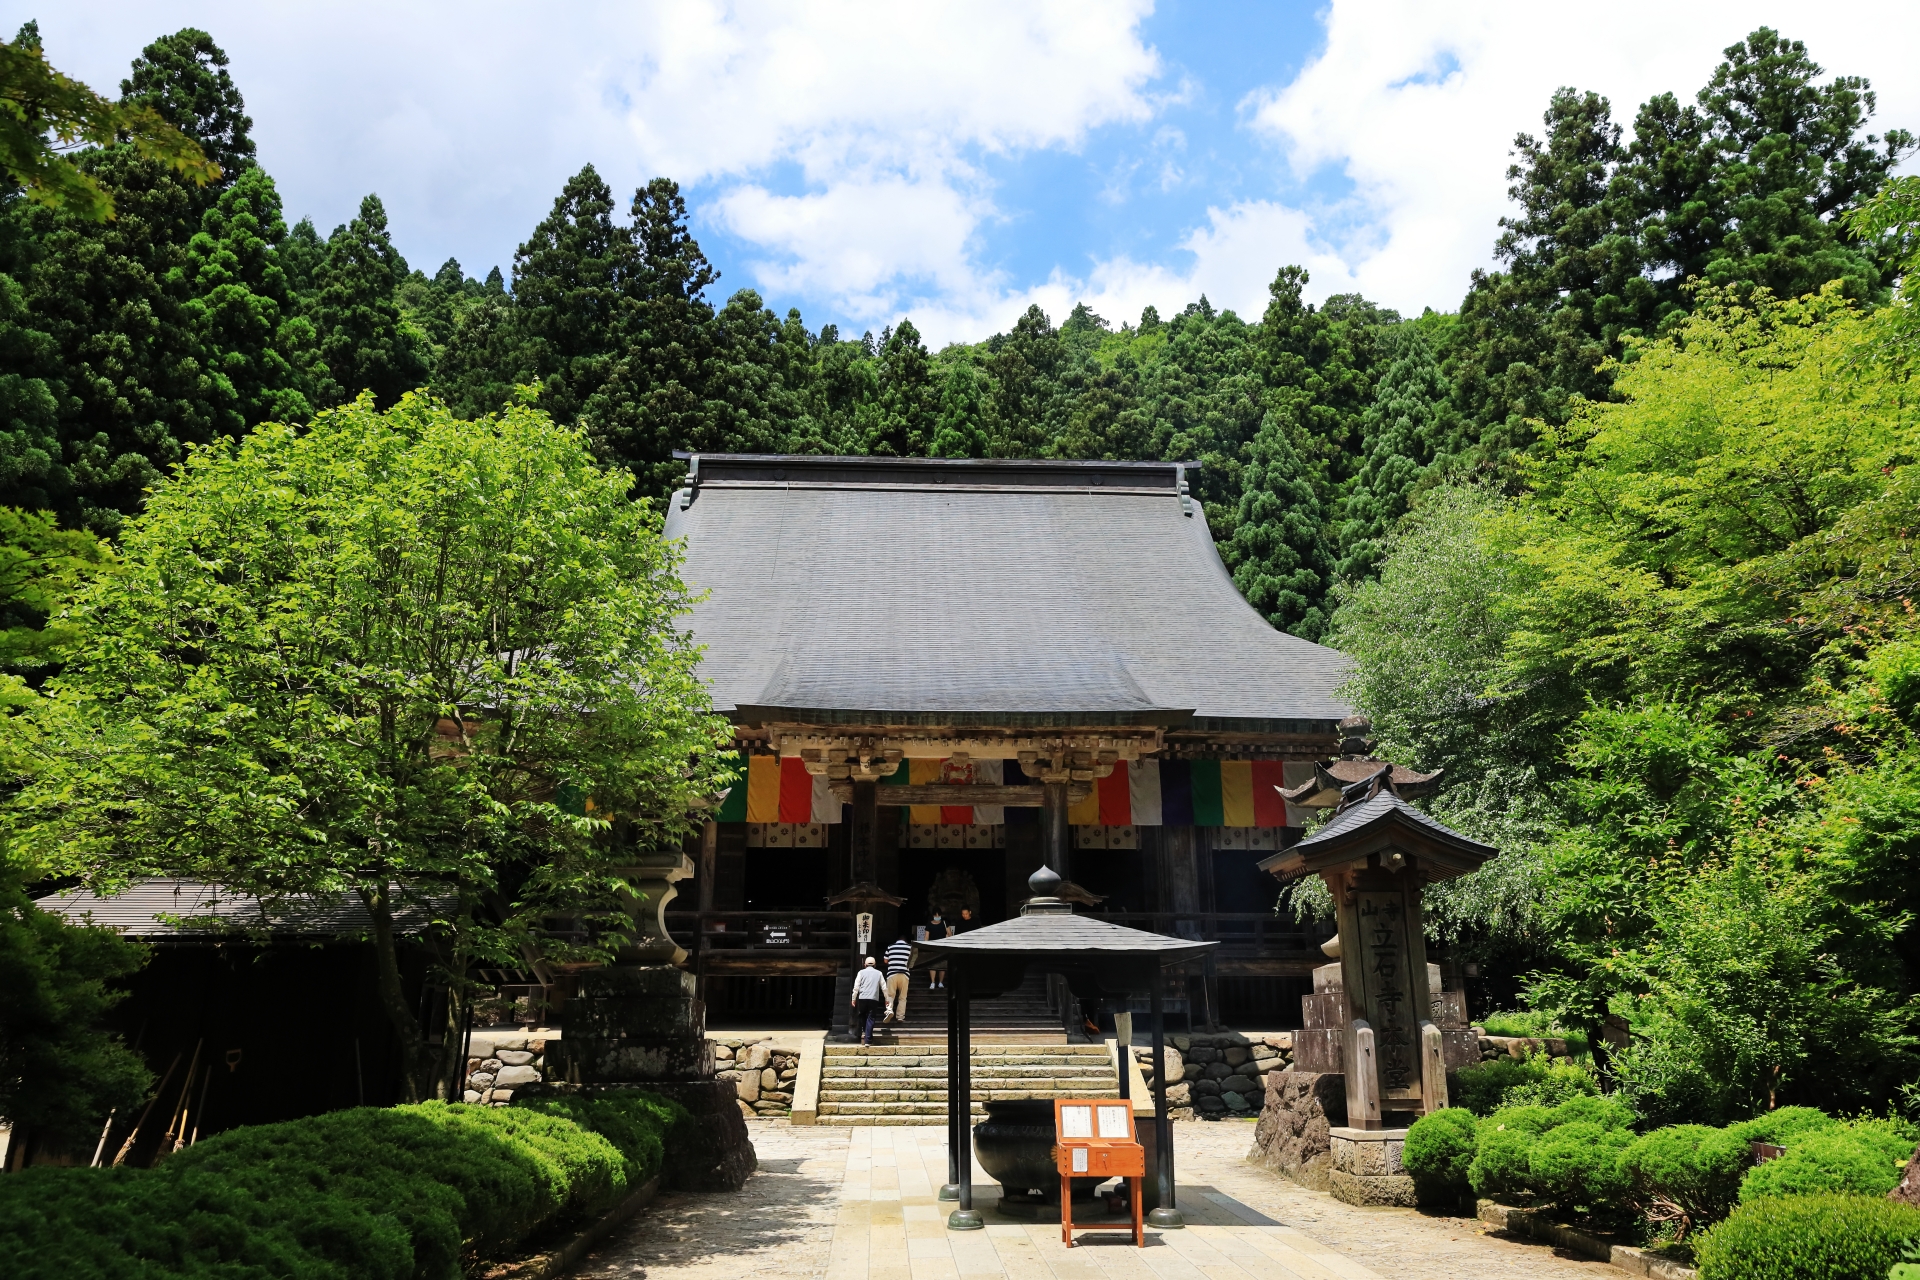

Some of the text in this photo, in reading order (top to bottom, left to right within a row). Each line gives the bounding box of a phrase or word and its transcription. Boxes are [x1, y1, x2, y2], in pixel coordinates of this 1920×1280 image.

[1361, 899, 1401, 921] 山寺
[1371, 923, 1410, 1090] 立石寺本堂
